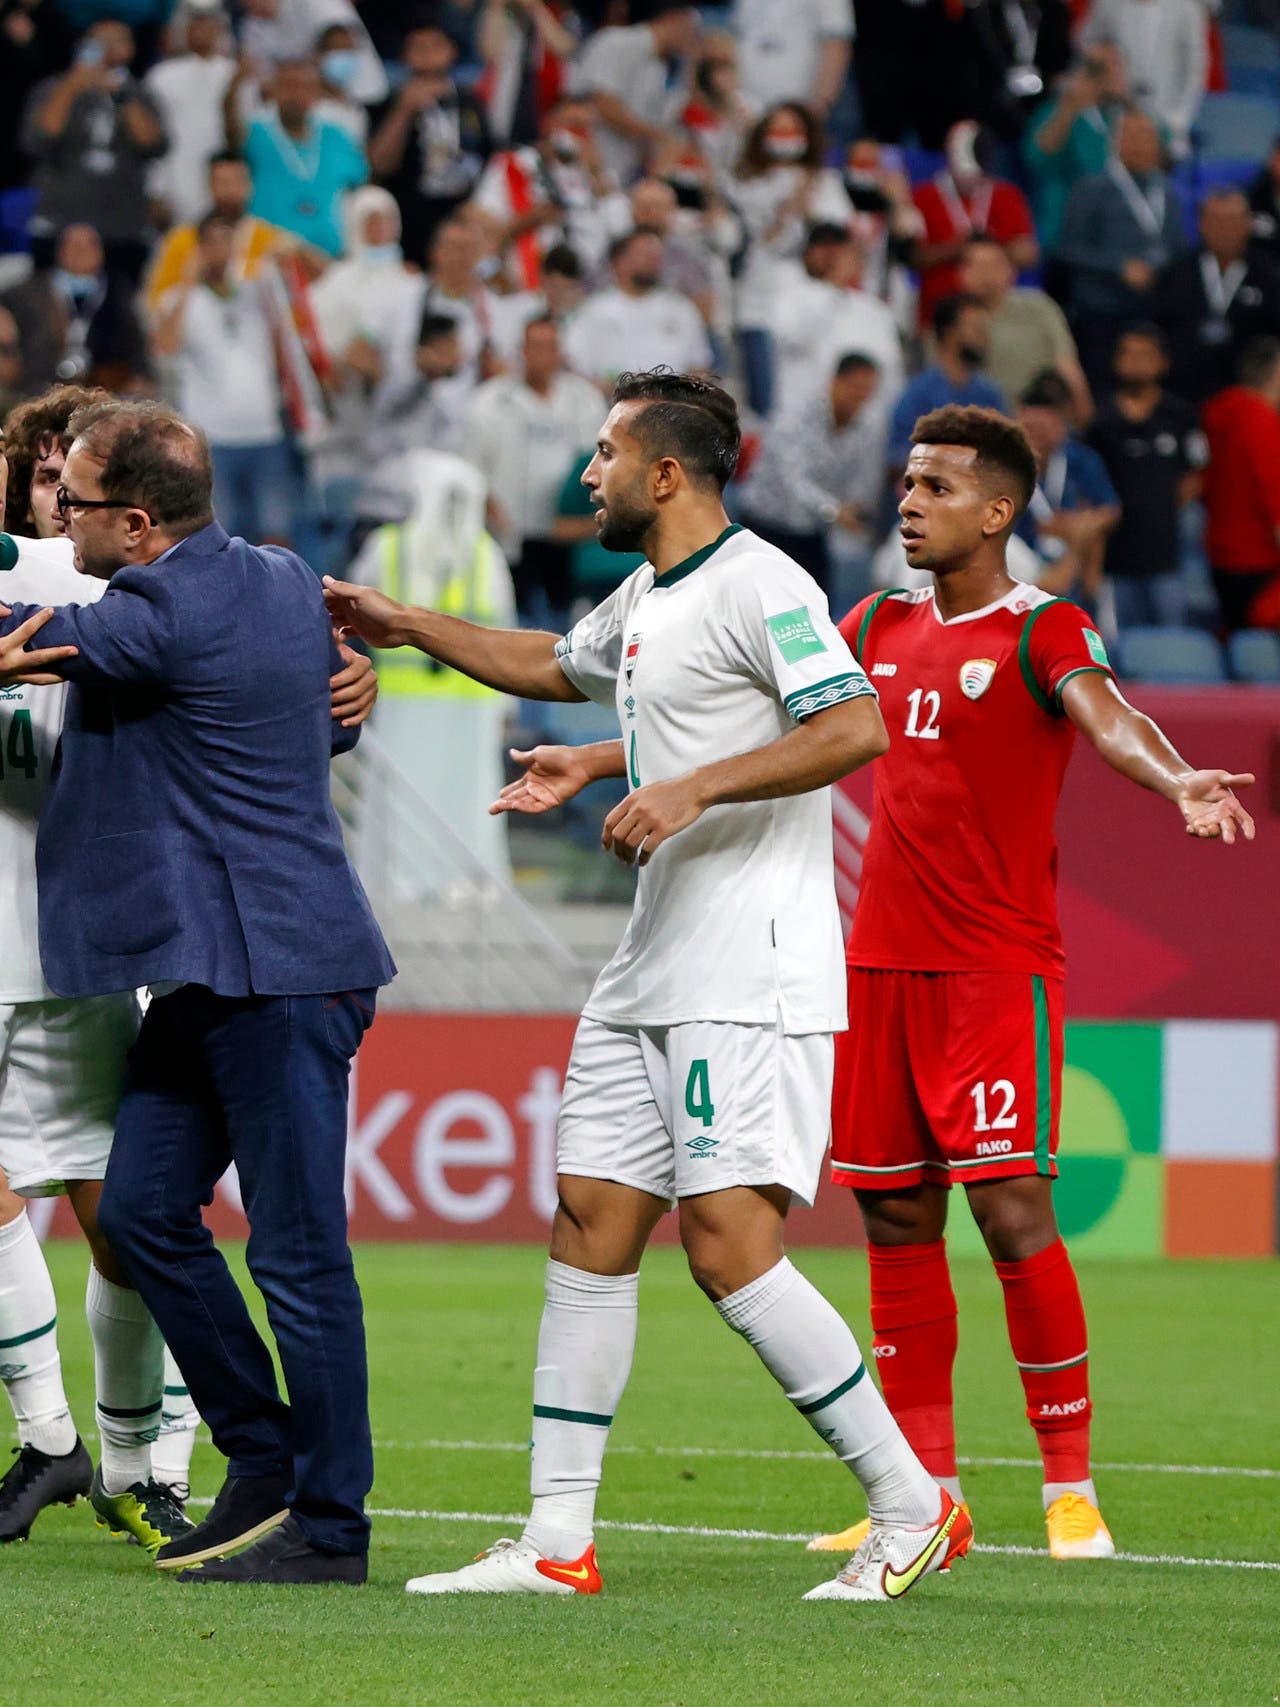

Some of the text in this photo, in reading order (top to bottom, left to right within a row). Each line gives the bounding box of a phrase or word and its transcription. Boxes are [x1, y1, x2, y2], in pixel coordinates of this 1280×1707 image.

[871, 662, 898, 677] JAKO
[904, 688, 941, 740] 12
[685, 1059, 715, 1127] 4
[970, 1079, 1019, 1132] 12
[343, 1067, 563, 1225] ket
[689, 1150, 718, 1159] umbro
[976, 1139, 1013, 1156] JAKO
[1039, 1397, 1088, 1416] JAKO
